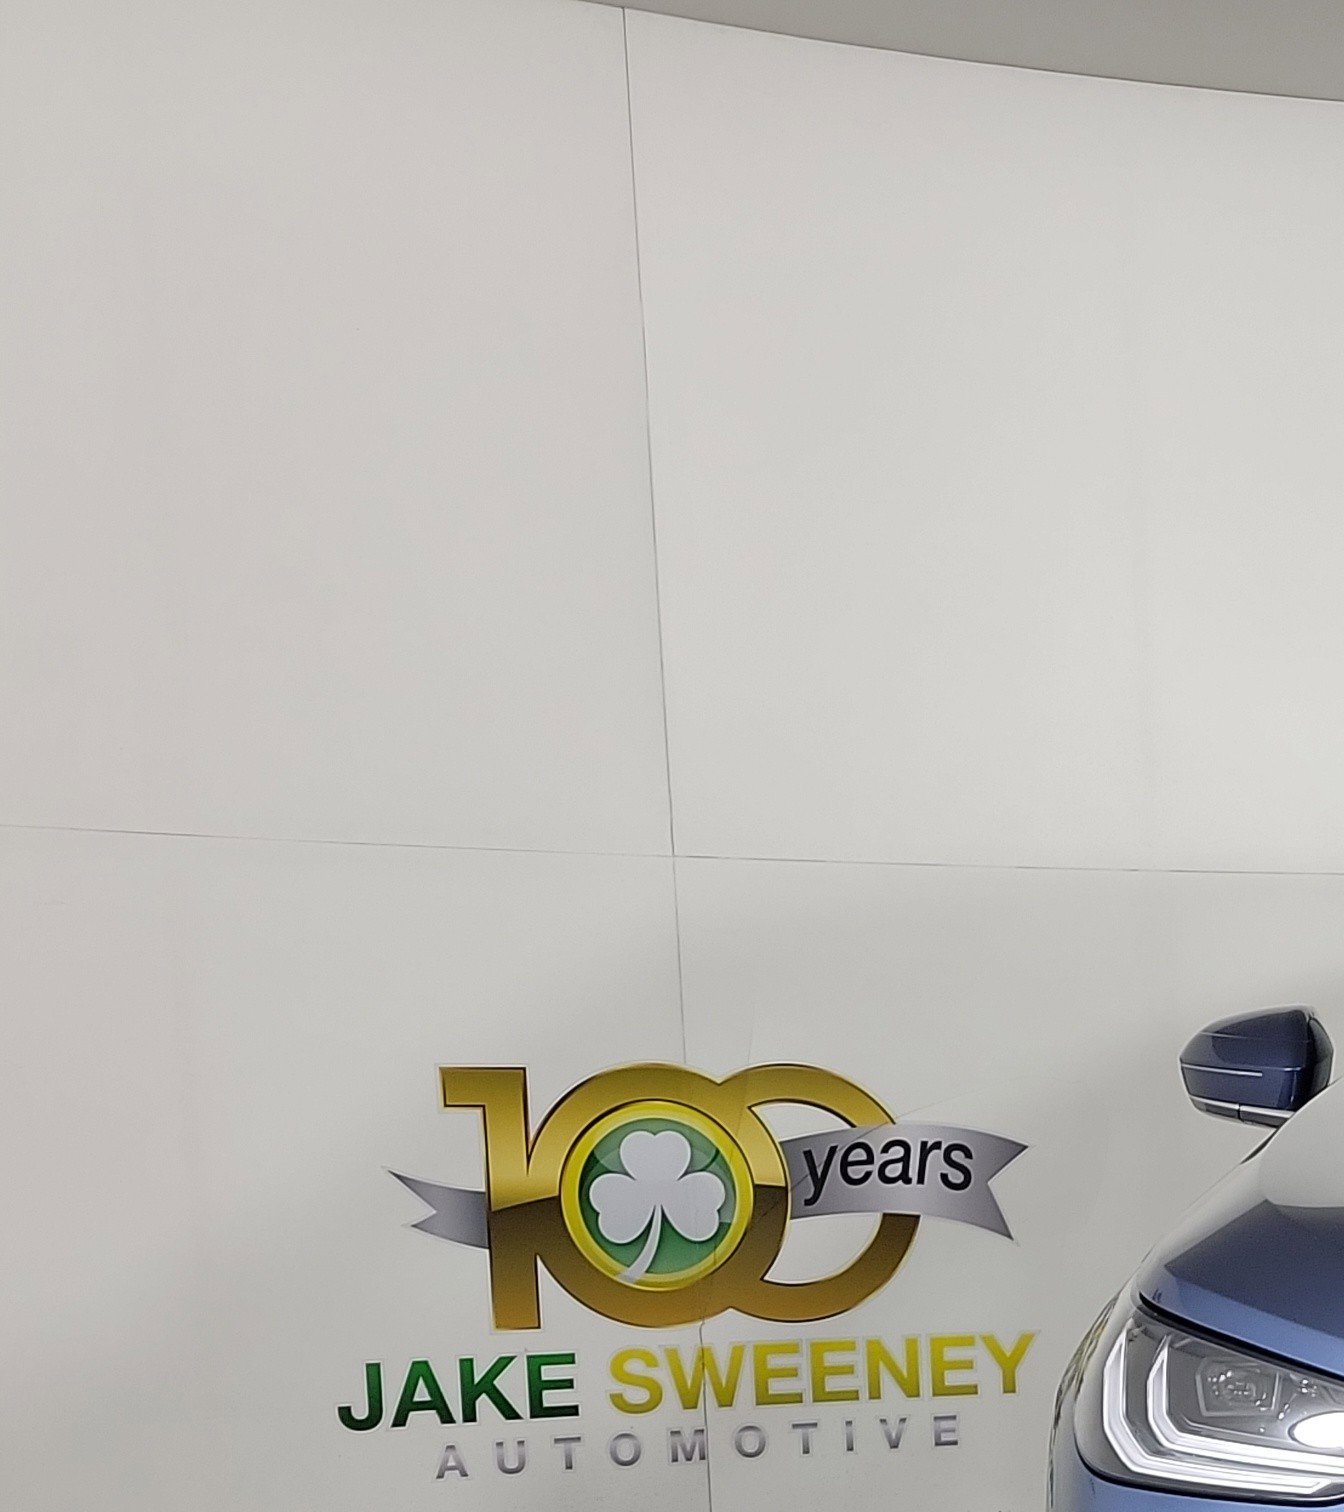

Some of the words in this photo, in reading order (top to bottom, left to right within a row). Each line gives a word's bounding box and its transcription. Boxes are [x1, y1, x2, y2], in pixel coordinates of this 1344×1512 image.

[438, 1061, 921, 1331] 100
[802, 1136, 974, 1207] years
[337, 1352, 580, 1433] JAKE
[608, 1332, 1036, 1416] SWEENEY
[434, 1413, 961, 1482] AUTOMOTIVE
